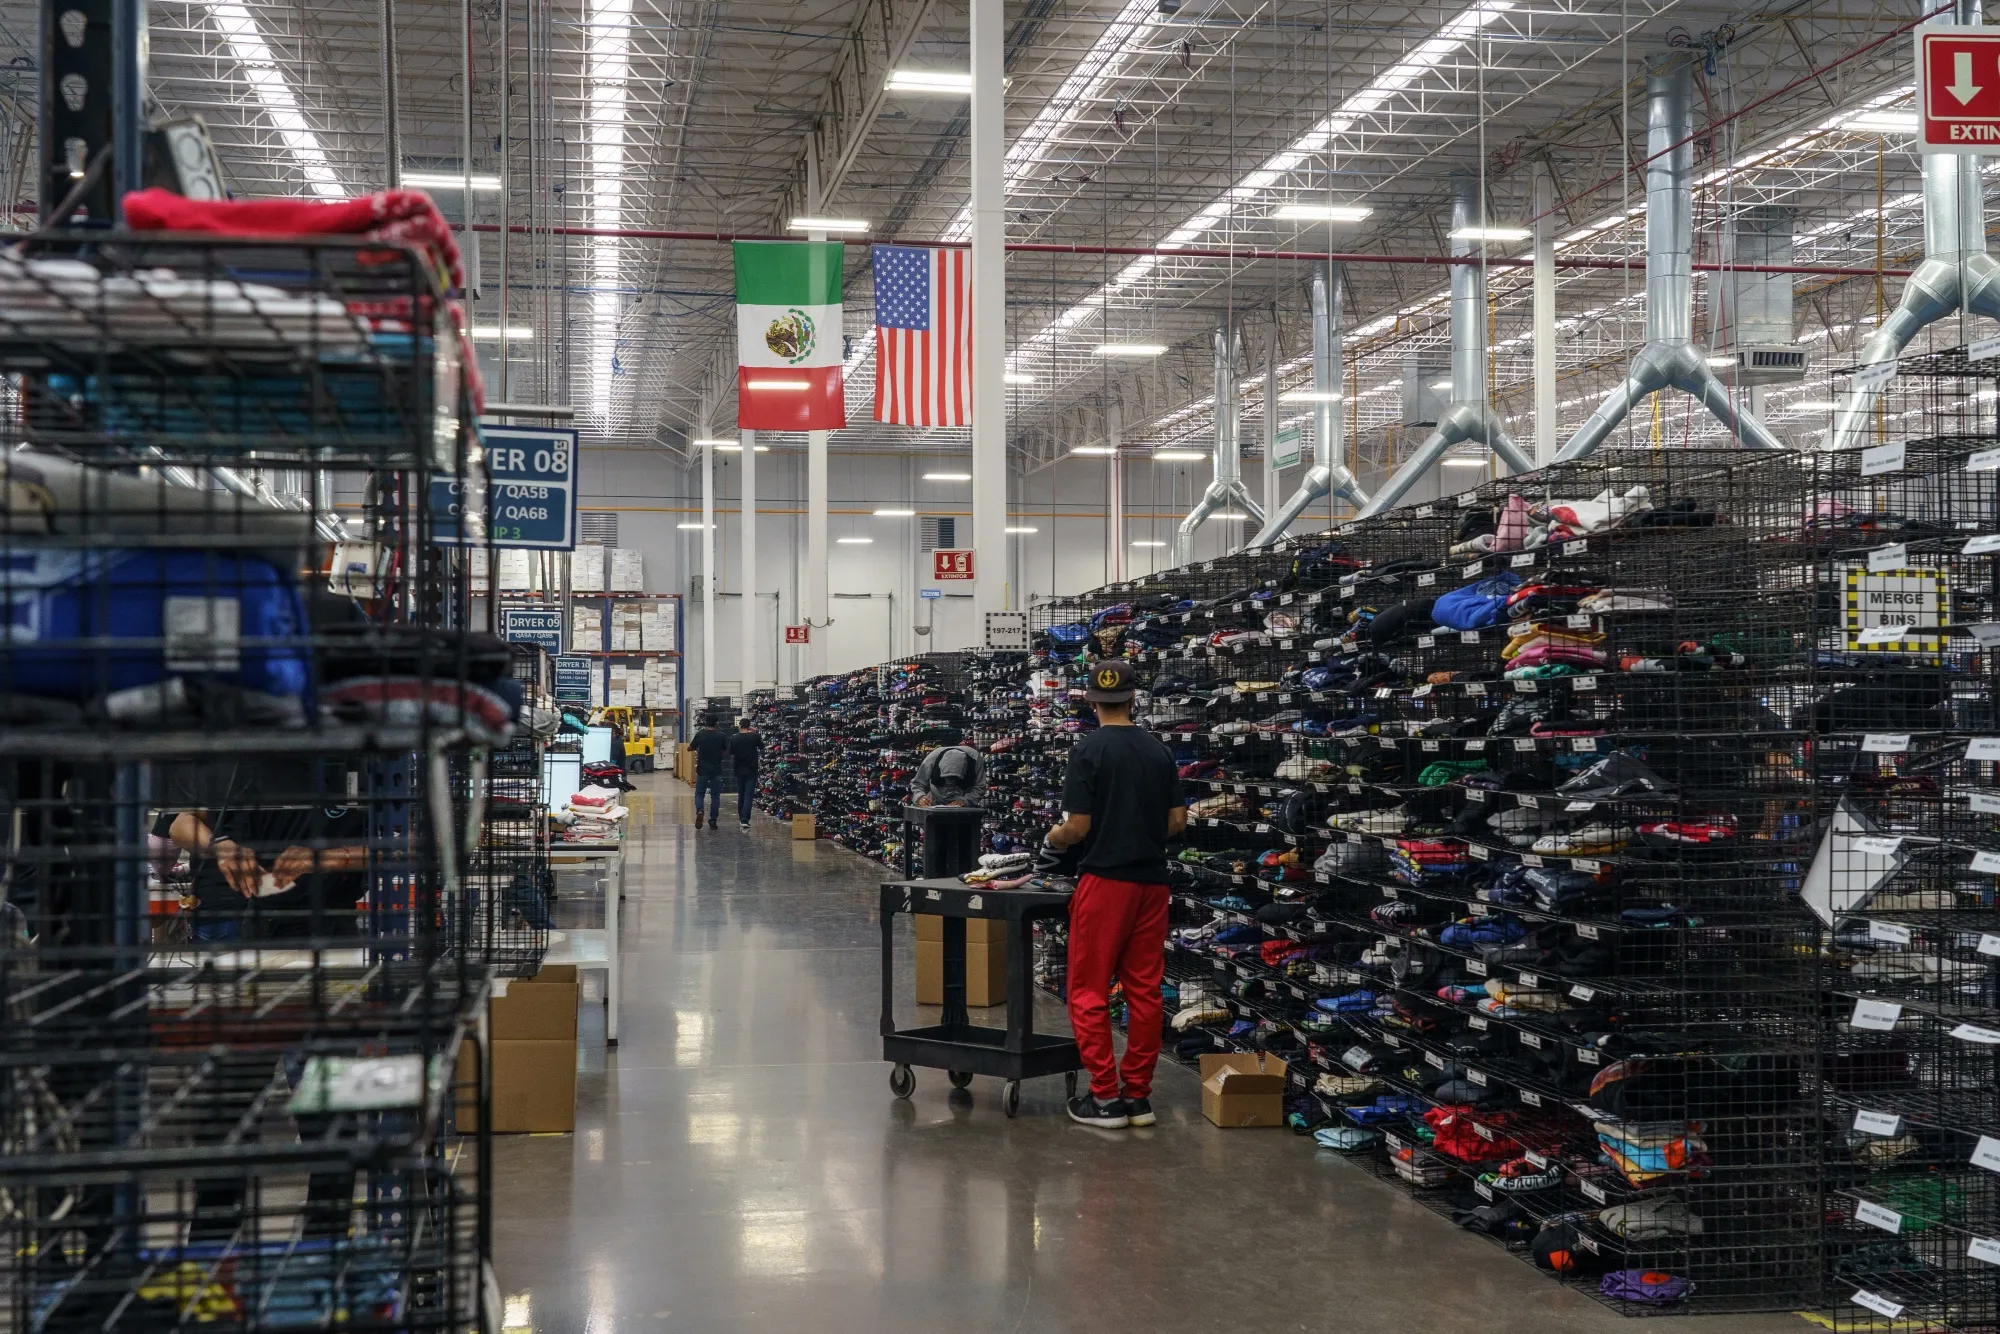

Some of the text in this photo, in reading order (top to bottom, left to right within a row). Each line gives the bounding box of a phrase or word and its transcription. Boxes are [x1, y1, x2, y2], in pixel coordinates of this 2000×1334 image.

[534, 450, 568, 473] 08
[506, 485, 549, 501] QA5B
[505, 505, 548, 521] QA6B
[512, 526, 521, 540] 3
[1870, 592, 1925, 605] MERGE
[510, 618, 560, 628] DRYER 09
[1879, 614, 1917, 626] BINS
